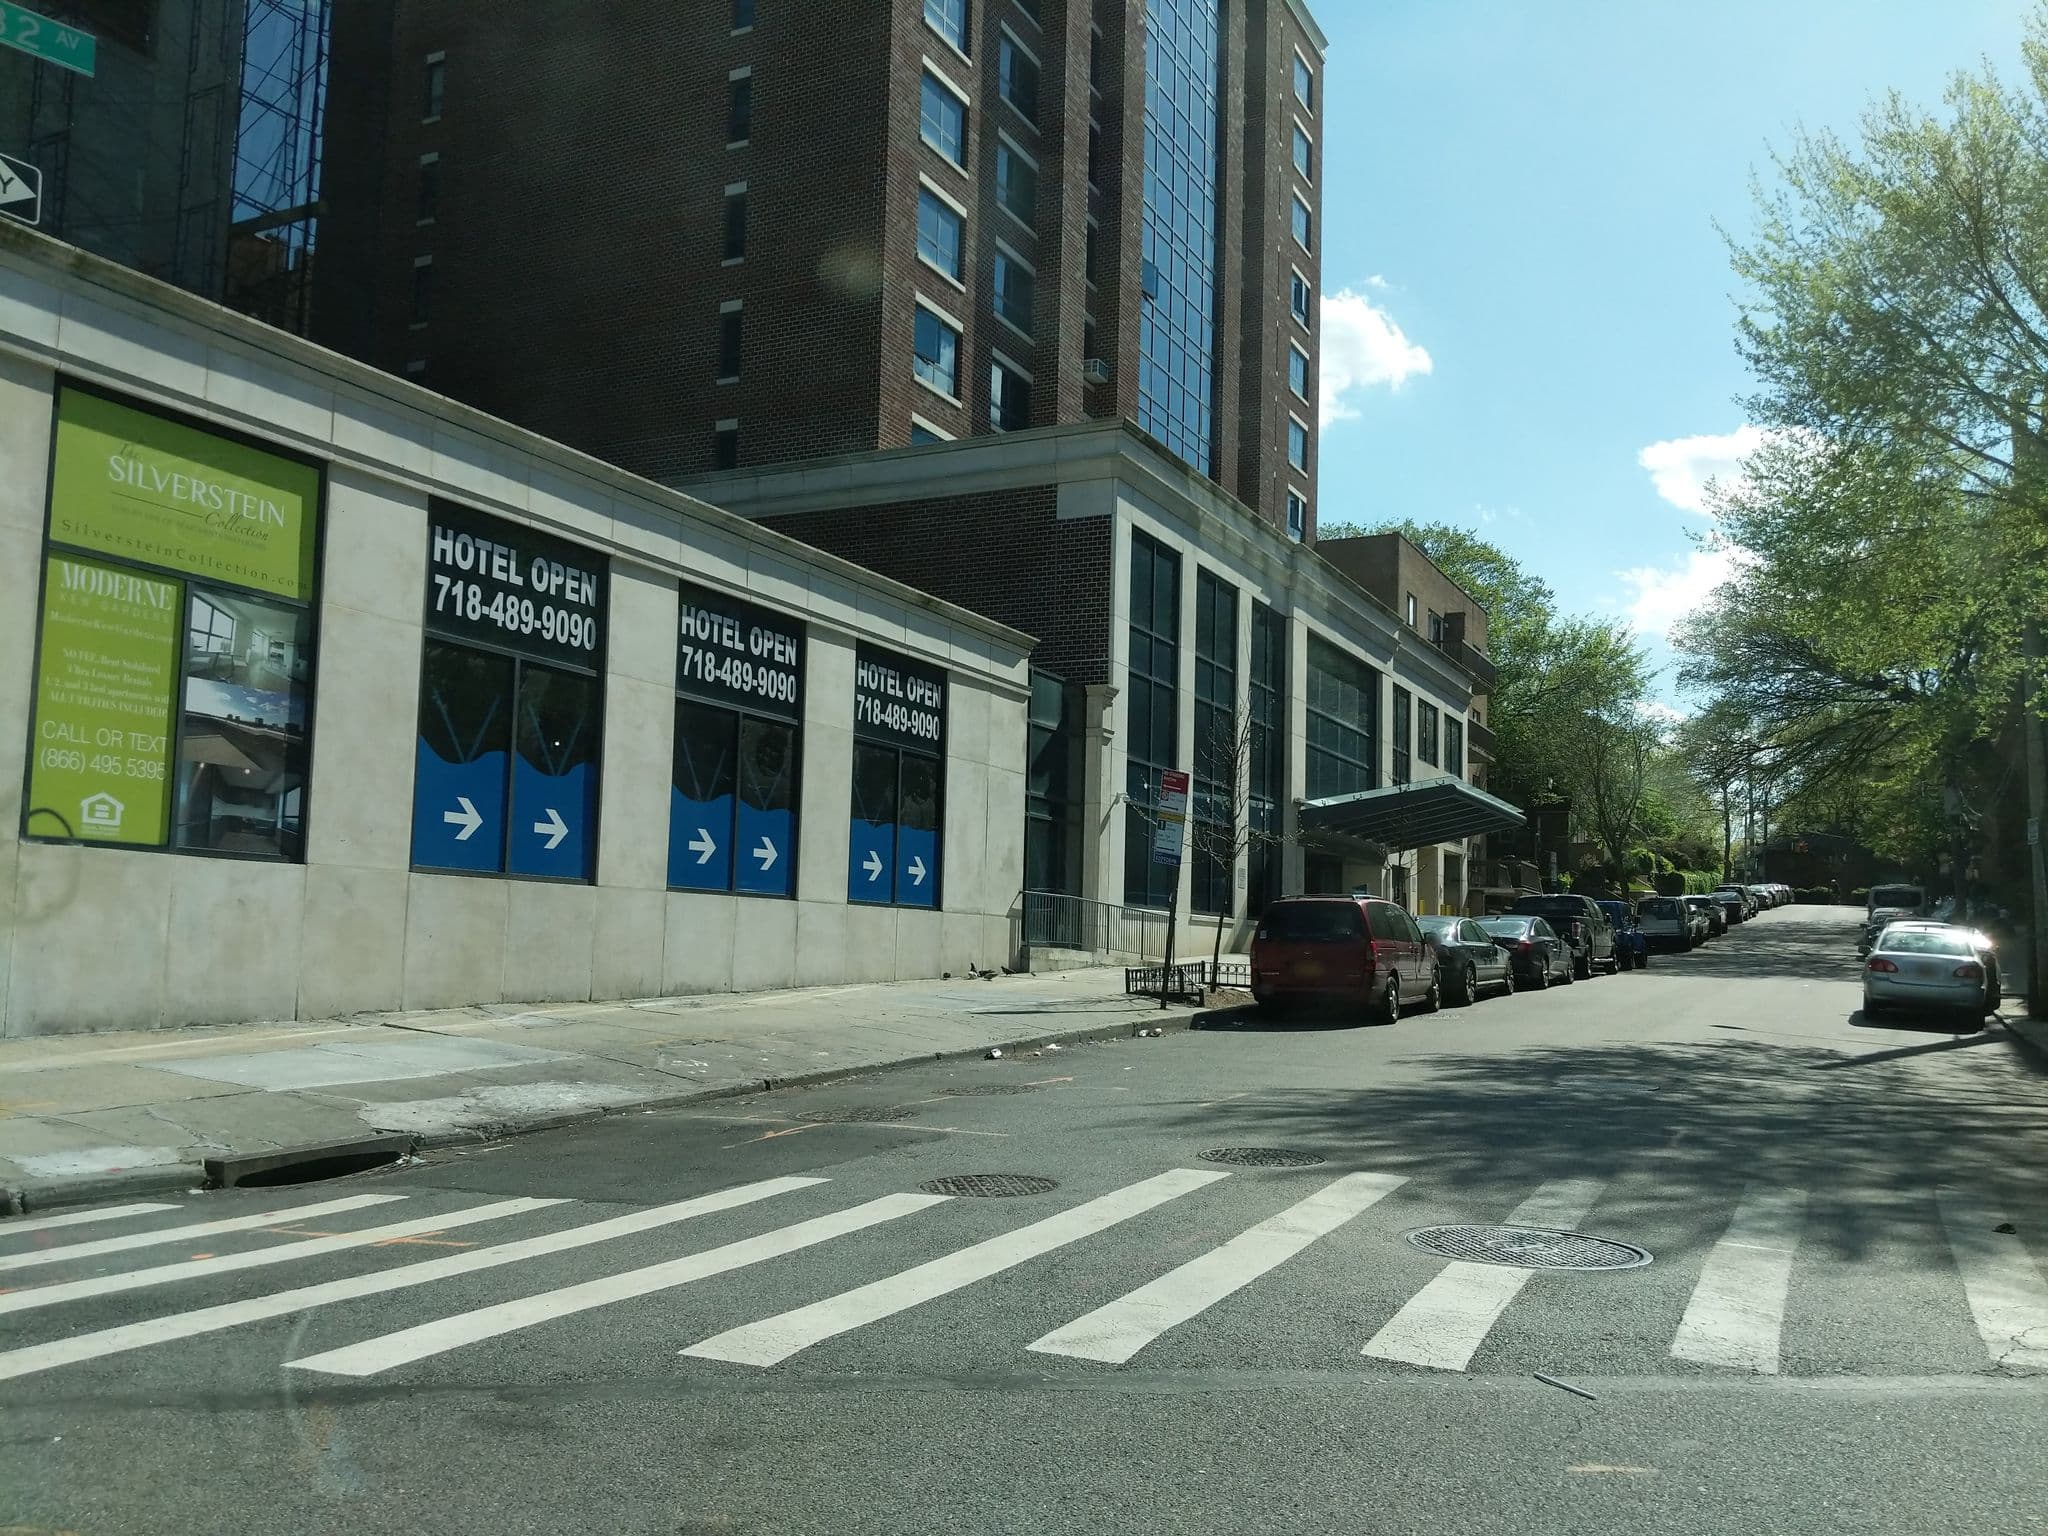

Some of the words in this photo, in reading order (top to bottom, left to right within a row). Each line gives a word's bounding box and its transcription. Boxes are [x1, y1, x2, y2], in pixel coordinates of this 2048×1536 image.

[56, 30, 80, 50] AV
[108, 455, 286, 527] SILVERSTEIN
[205, 511, 270, 541] Collection
[61, 561, 172, 611] MODERNE
[433, 525, 524, 586] HOTEL
[531, 557, 597, 607] OPEN
[434, 574, 597, 651] 718-489-9090
[681, 604, 745, 651] HOTEL
[750, 626, 797, 666] OPEN
[681, 645, 797, 704] 718-489-9090
[857, 660, 904, 698] HOTEL
[907, 676, 942, 710] OPEN
[42, 720, 91, 744] CALL
[96, 728, 123, 748] OR
[128, 732, 167, 753] TEXT
[856, 694, 940, 741] 718-489-9090
[41, 747, 86, 775] (866)
[90, 754, 122, 775] 495
[127, 758, 166, 781] 5395
